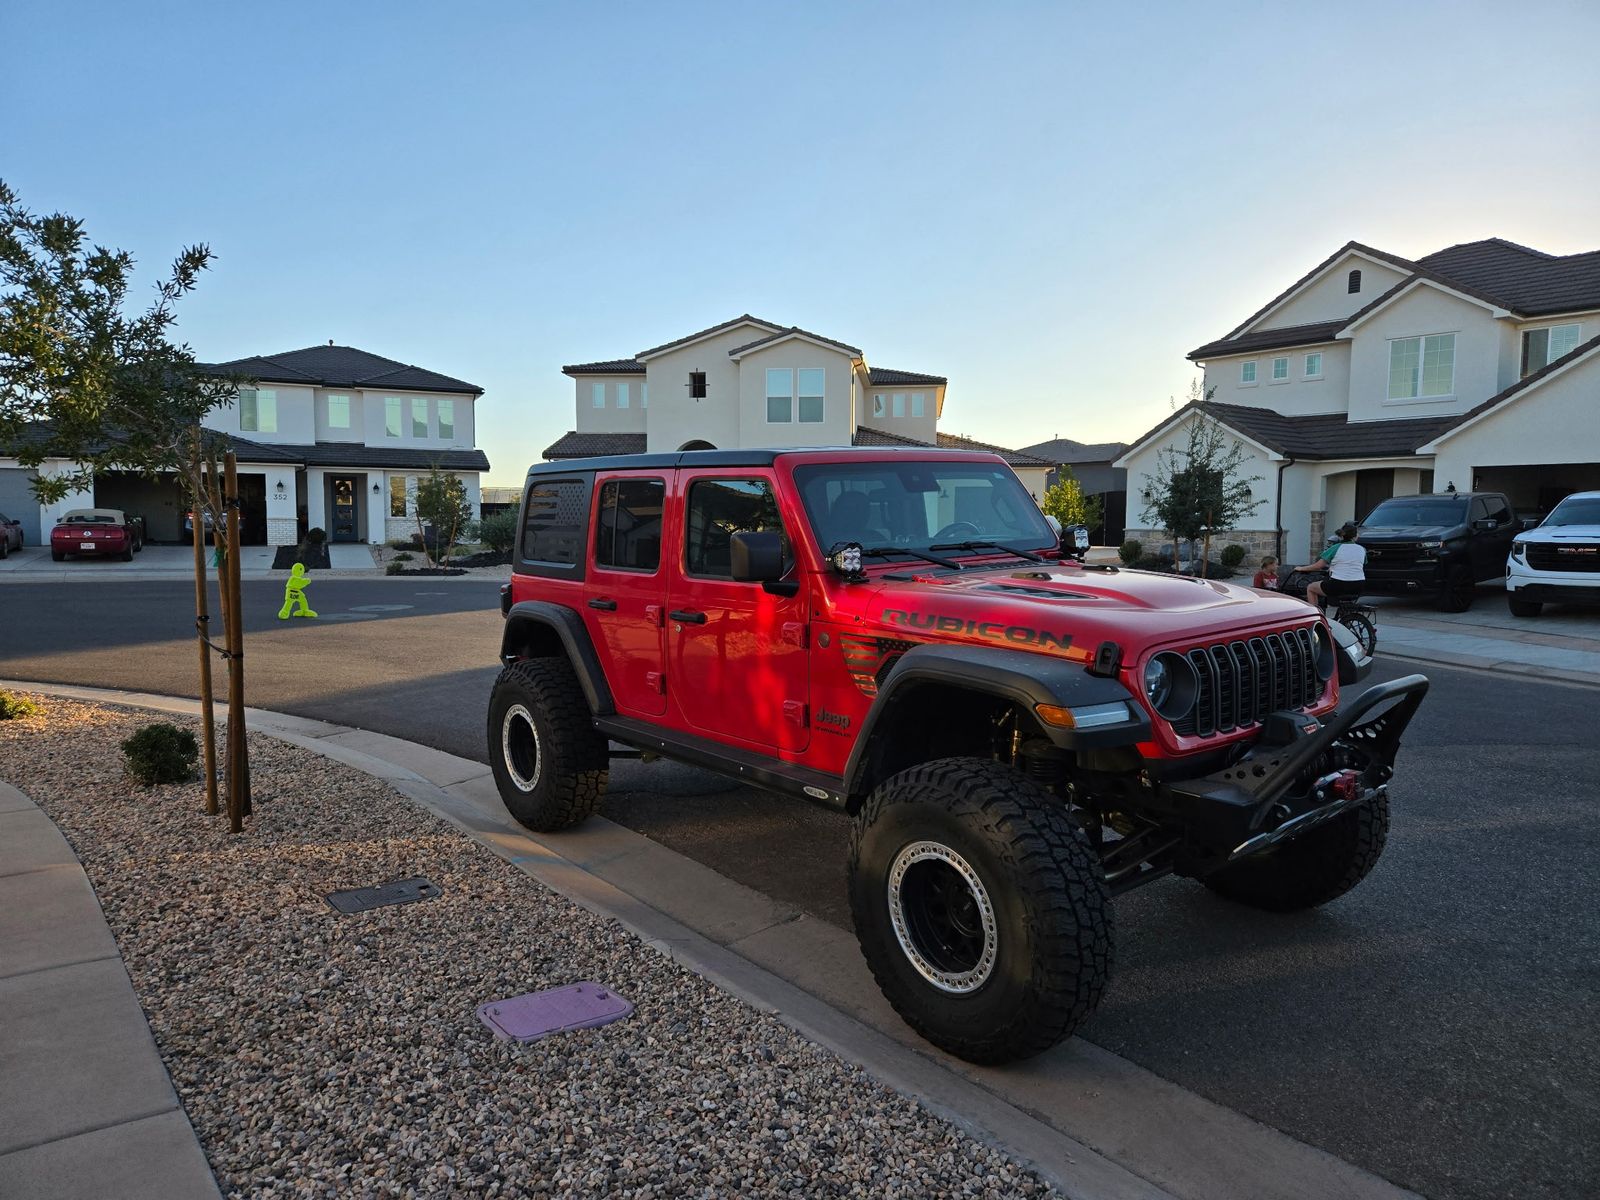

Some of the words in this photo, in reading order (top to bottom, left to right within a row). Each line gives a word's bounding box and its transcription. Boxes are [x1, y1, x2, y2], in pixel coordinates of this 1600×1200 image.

[273, 493, 288, 501] 352
[881, 608, 1073, 649] RUBICON
[815, 707, 850, 729] Jeep
